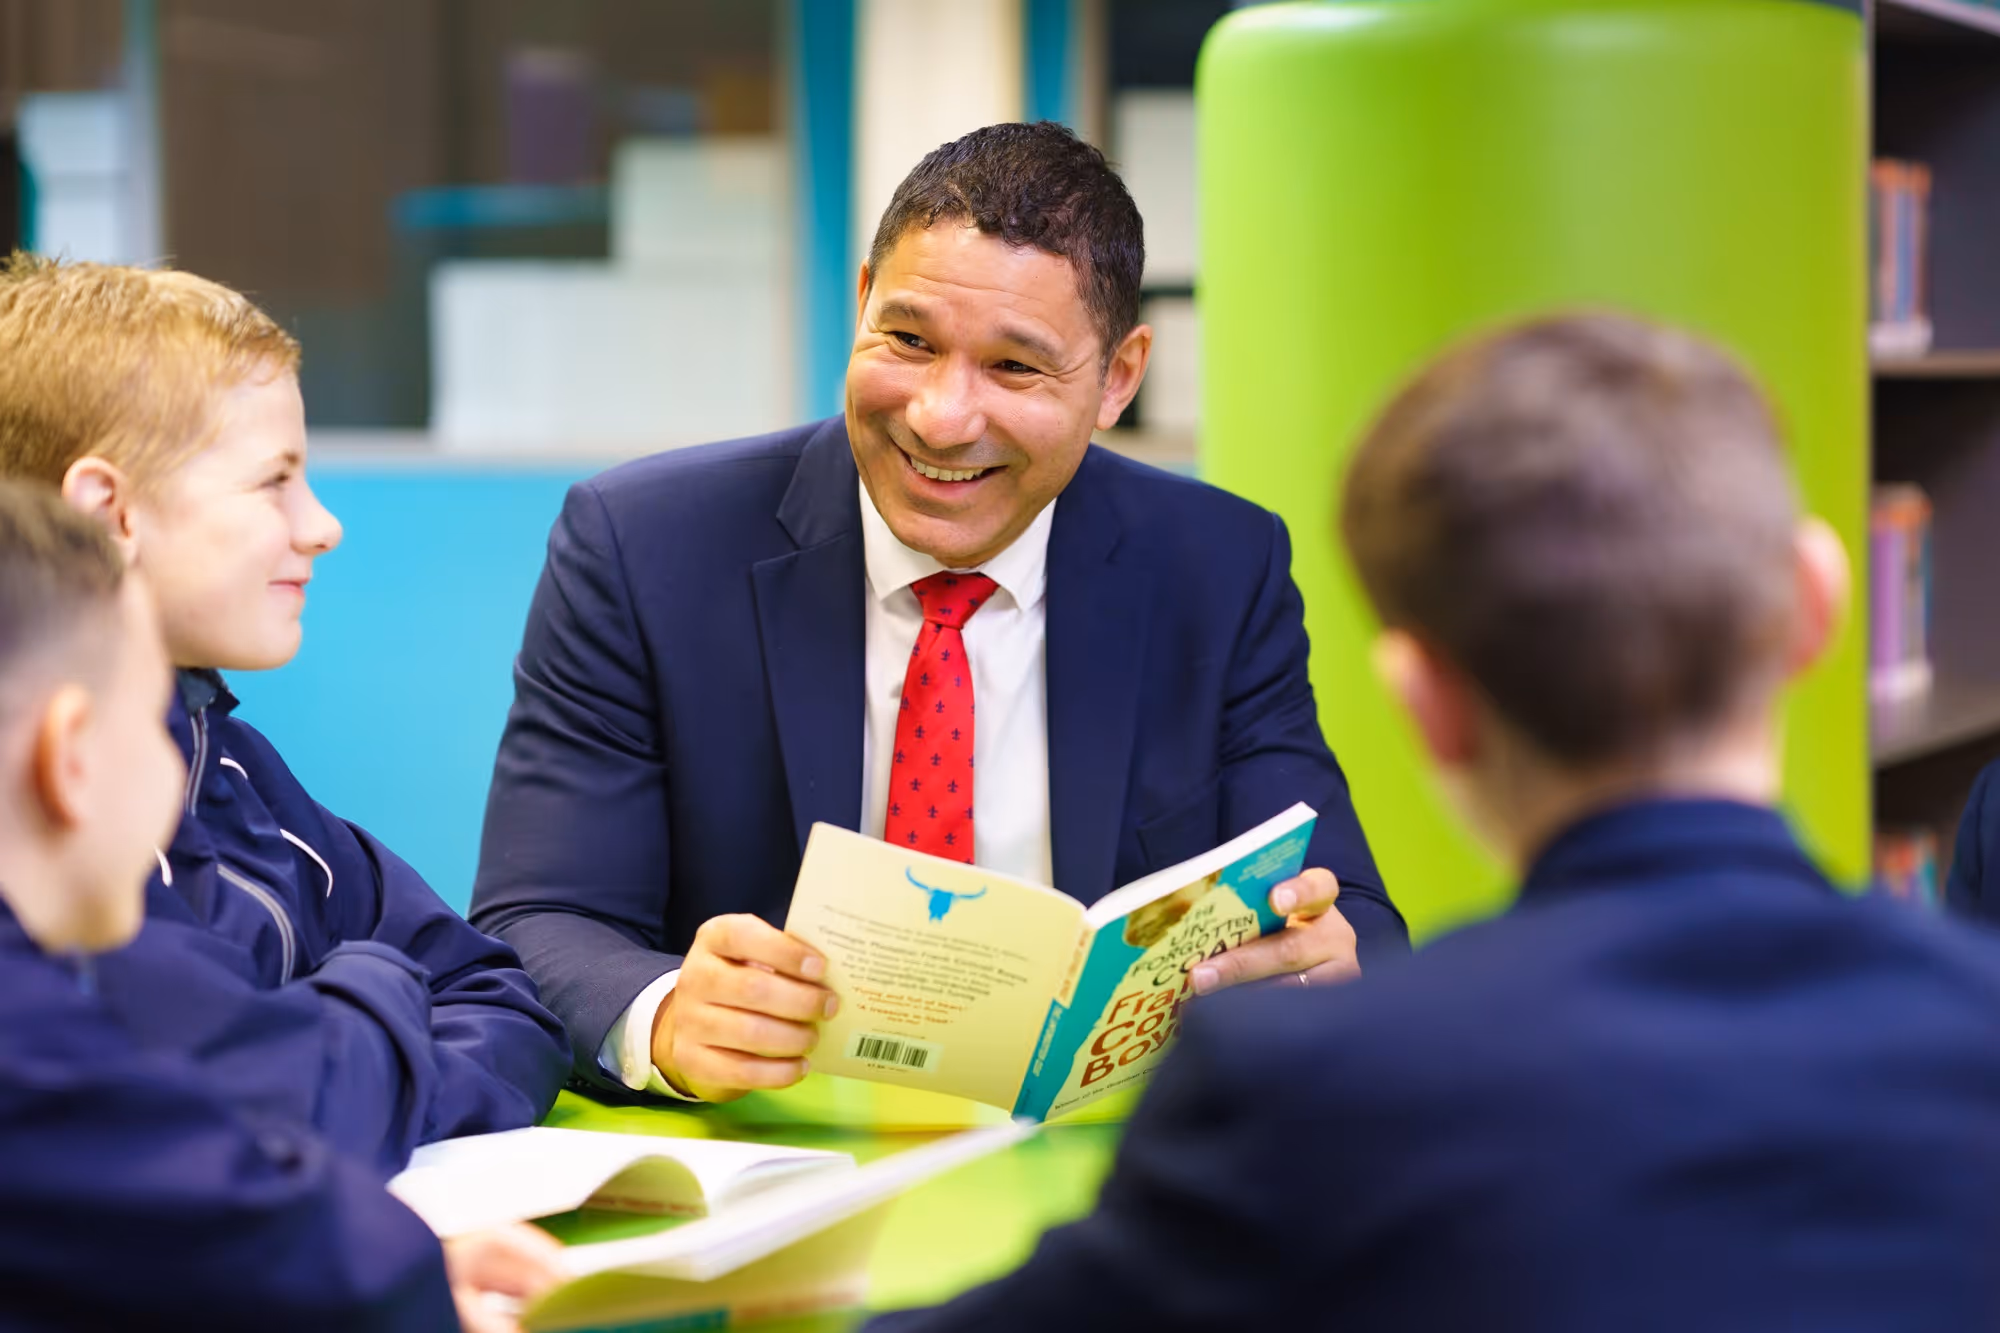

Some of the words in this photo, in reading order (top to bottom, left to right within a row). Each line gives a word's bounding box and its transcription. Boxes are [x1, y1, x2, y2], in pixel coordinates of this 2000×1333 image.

[1132, 913, 1254, 976] FORGOTTEN
[1152, 929, 1249, 986] COAT
[1091, 998, 1183, 1056] Cot
[1106, 976, 1190, 1024] Fra
[1079, 1022, 1182, 1088] Boy
